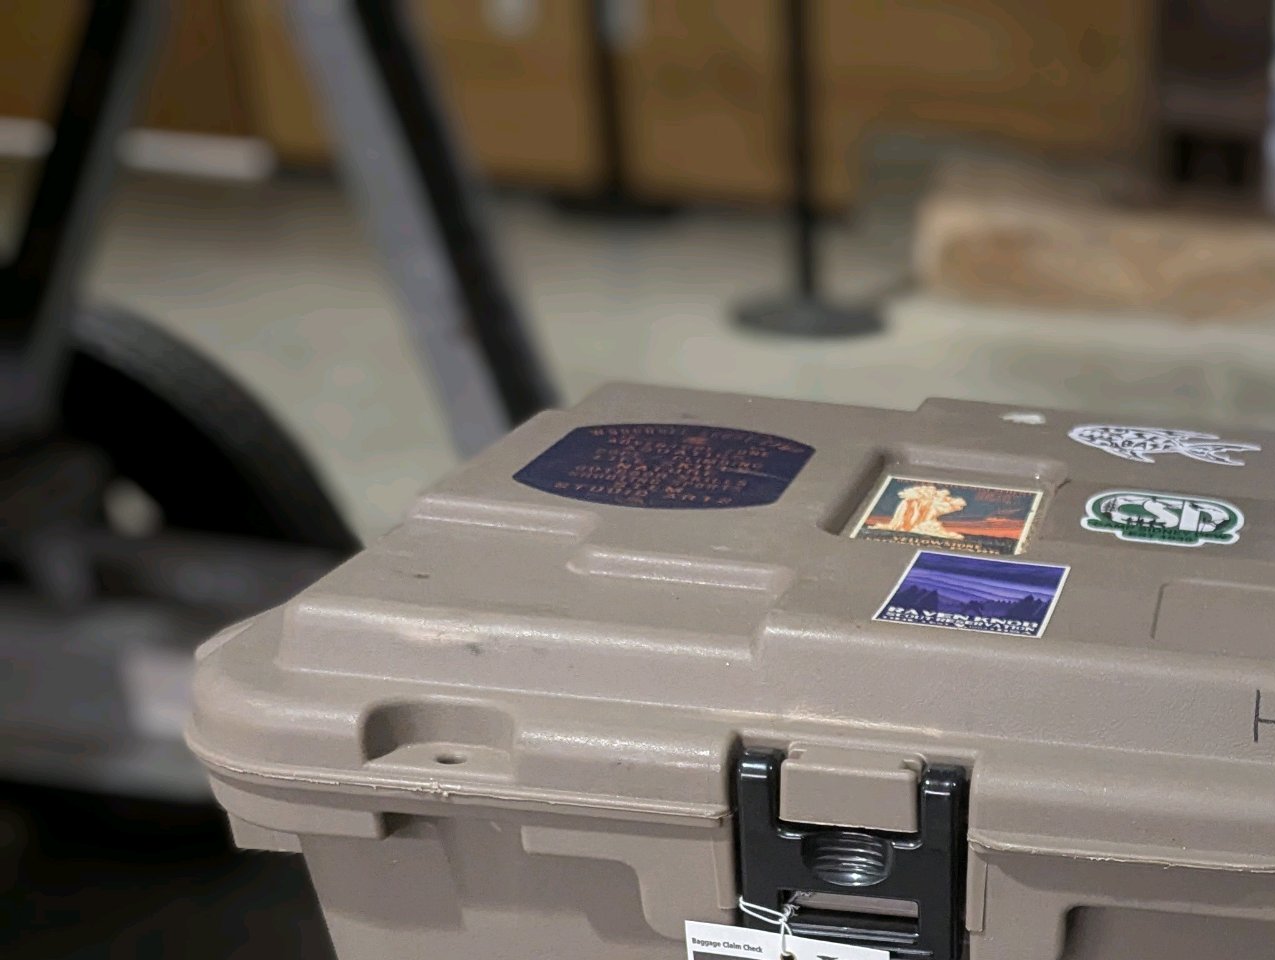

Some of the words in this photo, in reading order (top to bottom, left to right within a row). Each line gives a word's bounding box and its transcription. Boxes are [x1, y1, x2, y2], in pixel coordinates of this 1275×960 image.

[887, 606, 970, 621] RAVEN
[974, 616, 1039, 629] KNOB
[691, 937, 722, 949] Baggage
[722, 940, 742, 950] Claim
[743, 943, 763, 953] Check
